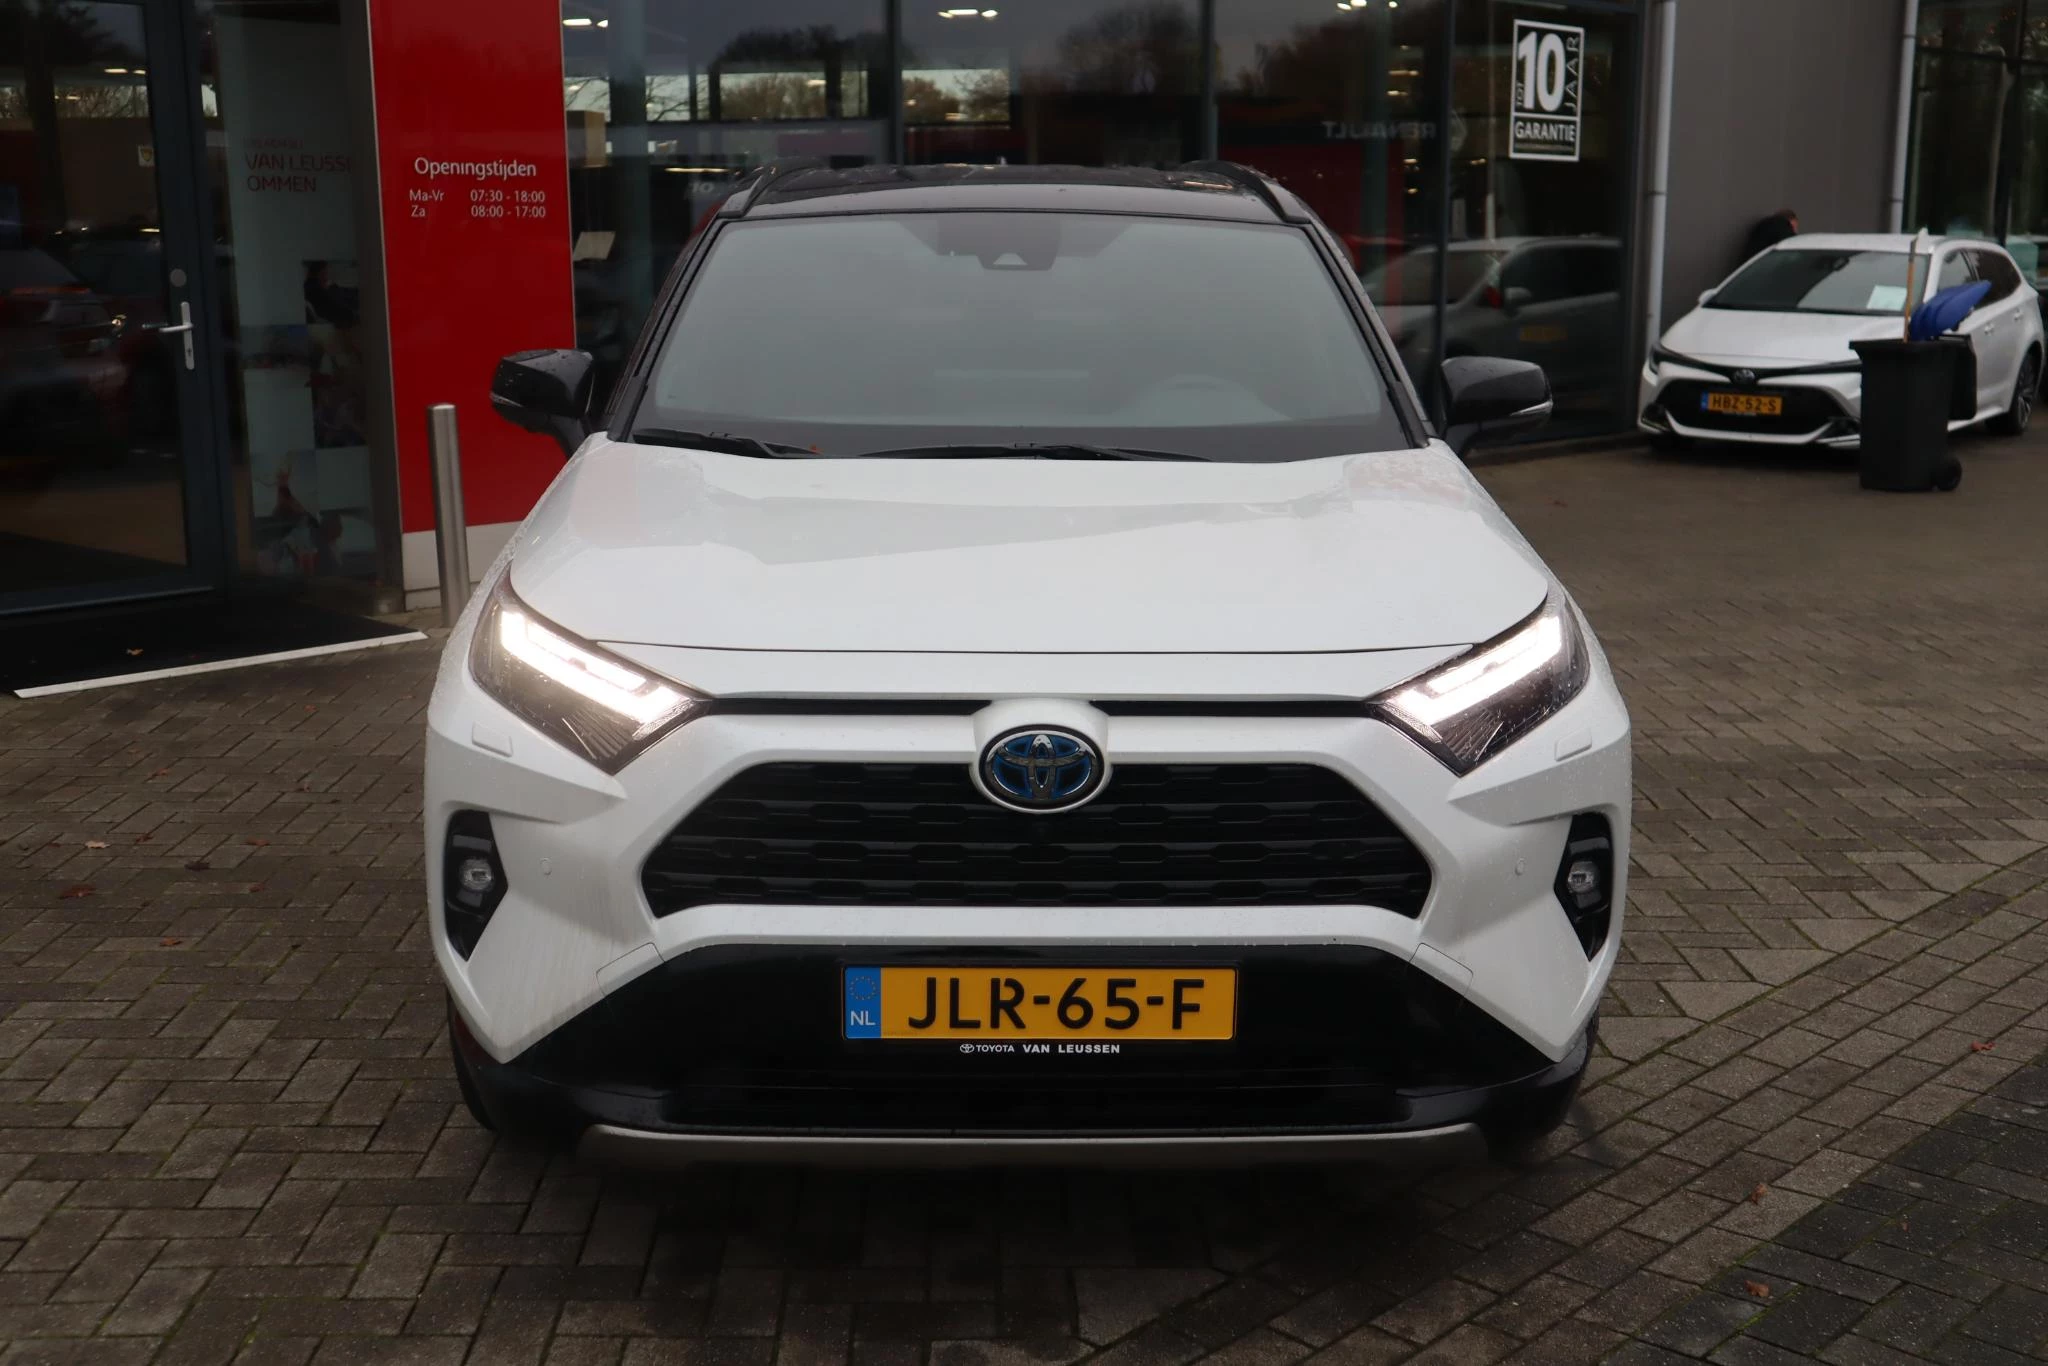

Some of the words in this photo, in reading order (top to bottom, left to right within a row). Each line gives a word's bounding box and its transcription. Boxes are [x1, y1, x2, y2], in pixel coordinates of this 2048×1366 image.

[1517, 31, 1566, 112] 10
[1563, 36, 1579, 113] JAAR
[1514, 120, 1577, 142] GARANTIE
[244, 152, 285, 171] VAN
[414, 156, 537, 182] Openingstijden
[246, 175, 317, 192] OMMEN
[409, 189, 445, 202] Ma-Vr
[470, 189, 503, 202] 07:30
[514, 190, 546, 203] 18:00
[411, 204, 426, 217] Za
[471, 205, 504, 218] 08:00
[515, 205, 546, 218] 17:00
[1712, 394, 1777, 412] HBZ-52-S
[908, 978, 1205, 1029] JLR-65-F
[850, 1010, 876, 1026] NL
[976, 1044, 1015, 1053] TOYOTA
[1022, 1043, 1051, 1054] VAN
[1057, 1043, 1121, 1054] LEUSSEN
